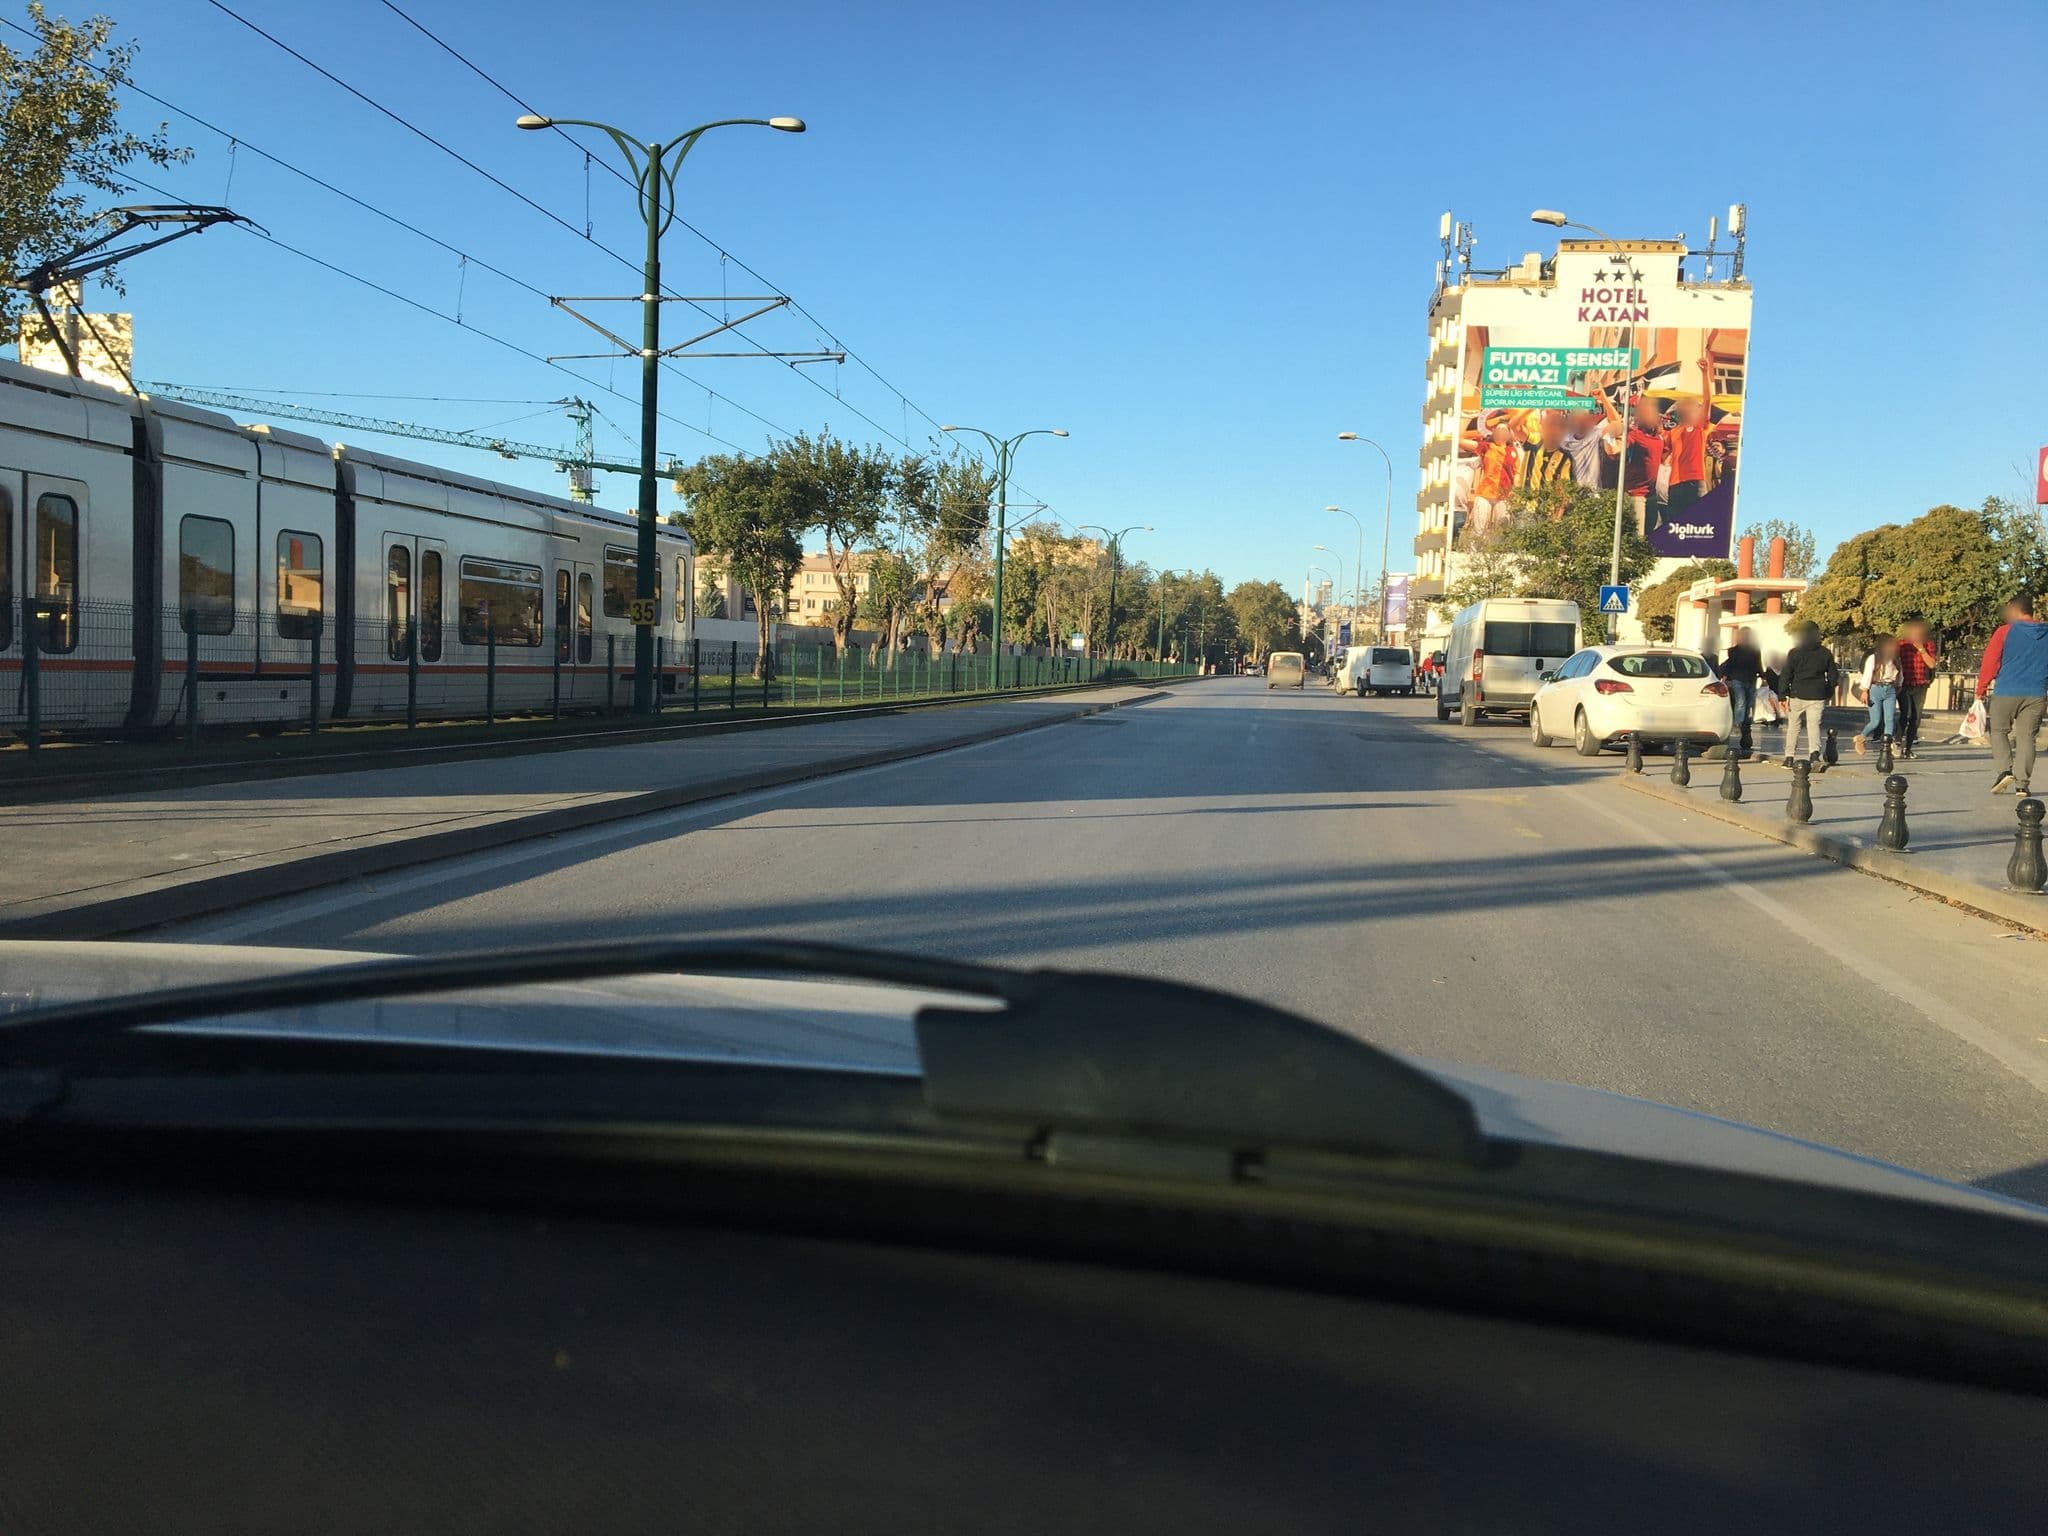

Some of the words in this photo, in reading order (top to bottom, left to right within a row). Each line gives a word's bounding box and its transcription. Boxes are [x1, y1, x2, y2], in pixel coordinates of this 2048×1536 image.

[1582, 288, 1647, 304] HOTEL
[1578, 307, 1649, 322] KATAN
[1489, 351, 1561, 366] FUTBOL
[1565, 350, 1630, 367] SENSİZ
[1488, 368, 1559, 383] OLMAZ!
[1484, 398, 1517, 407] SPORUN
[1668, 522, 1715, 540] Digiturk
[633, 602, 653, 622] 35
